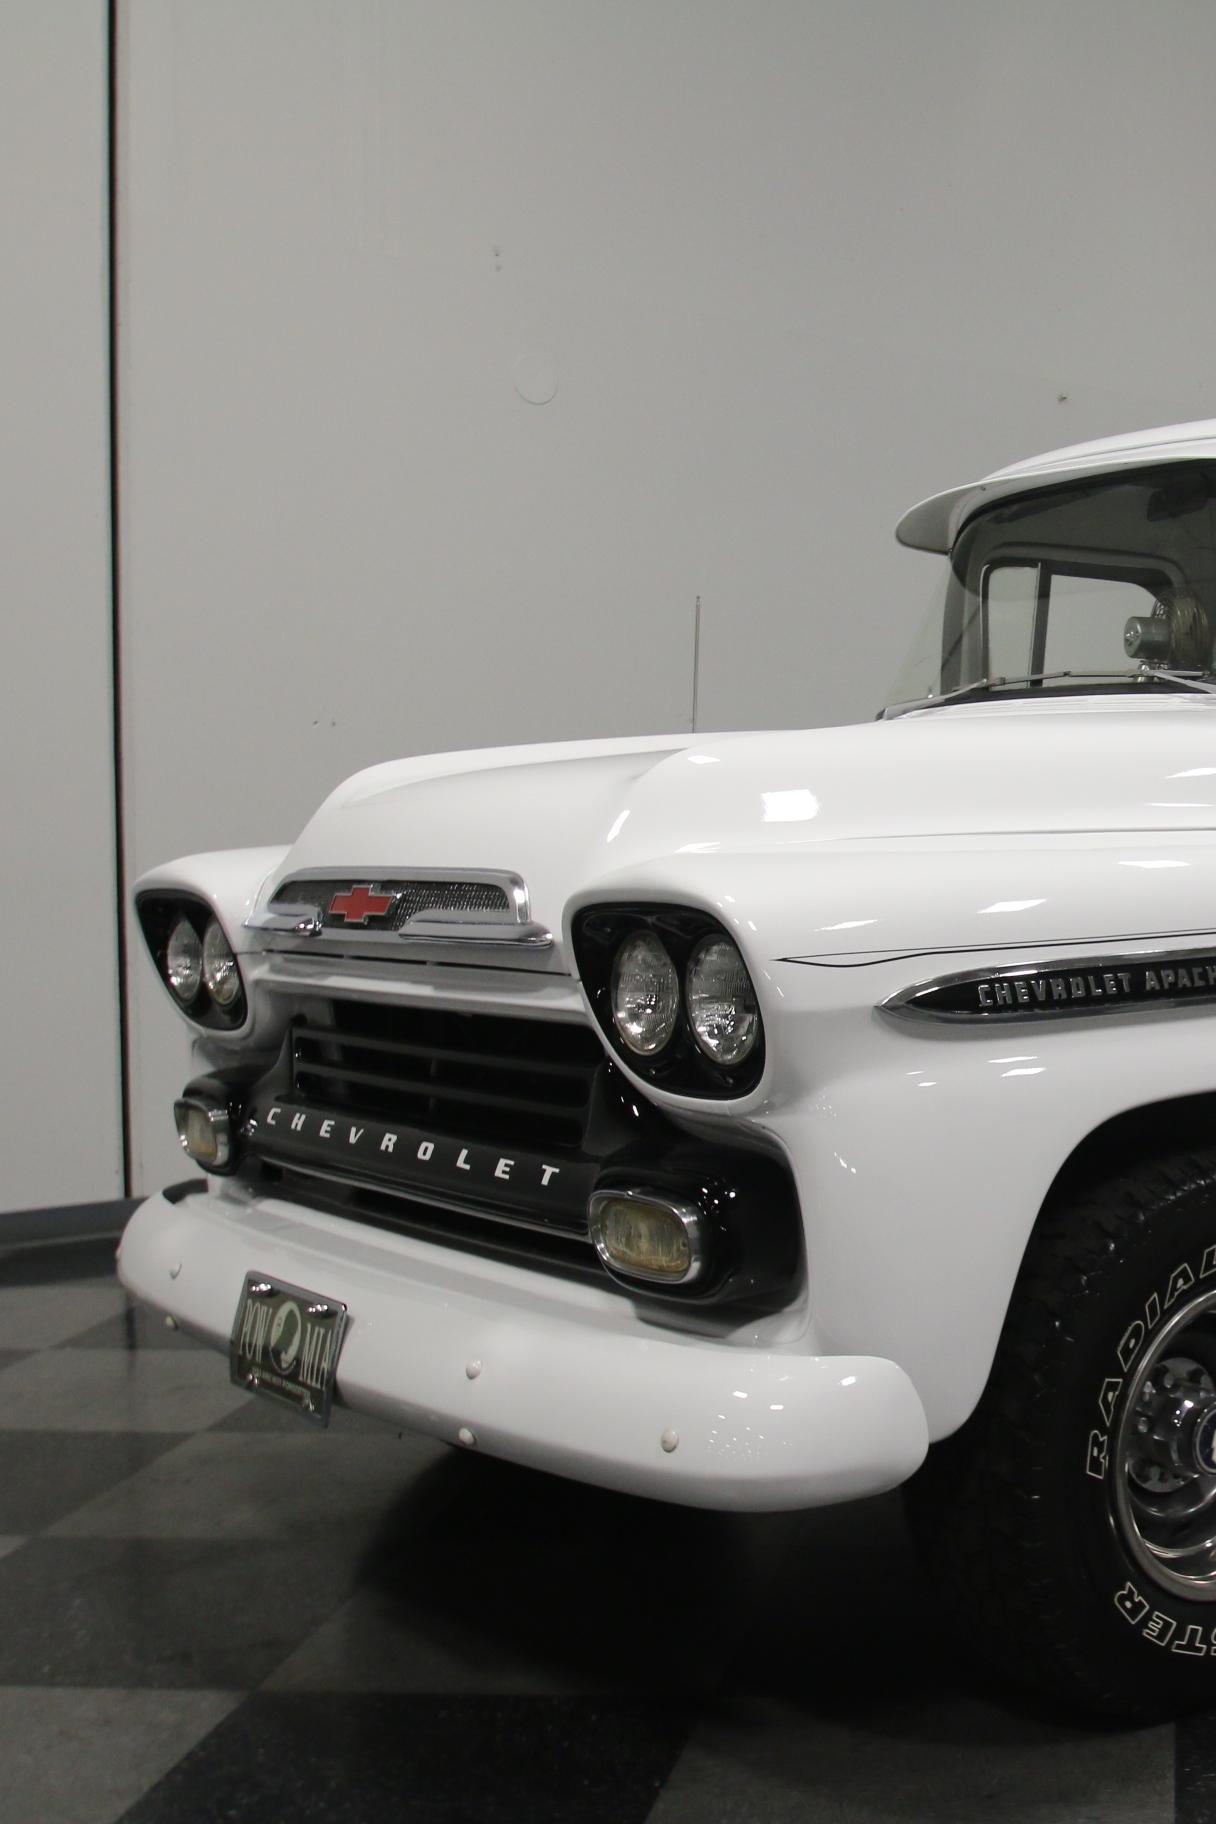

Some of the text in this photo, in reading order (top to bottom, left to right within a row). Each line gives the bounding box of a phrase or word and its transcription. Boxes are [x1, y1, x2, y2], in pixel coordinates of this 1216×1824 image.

[978, 970, 1132, 1008] CHEVROLET
[265, 1106, 560, 1187] CHEVROLET
[238, 1298, 273, 1364] POW
[299, 1322, 332, 1391] MIA
